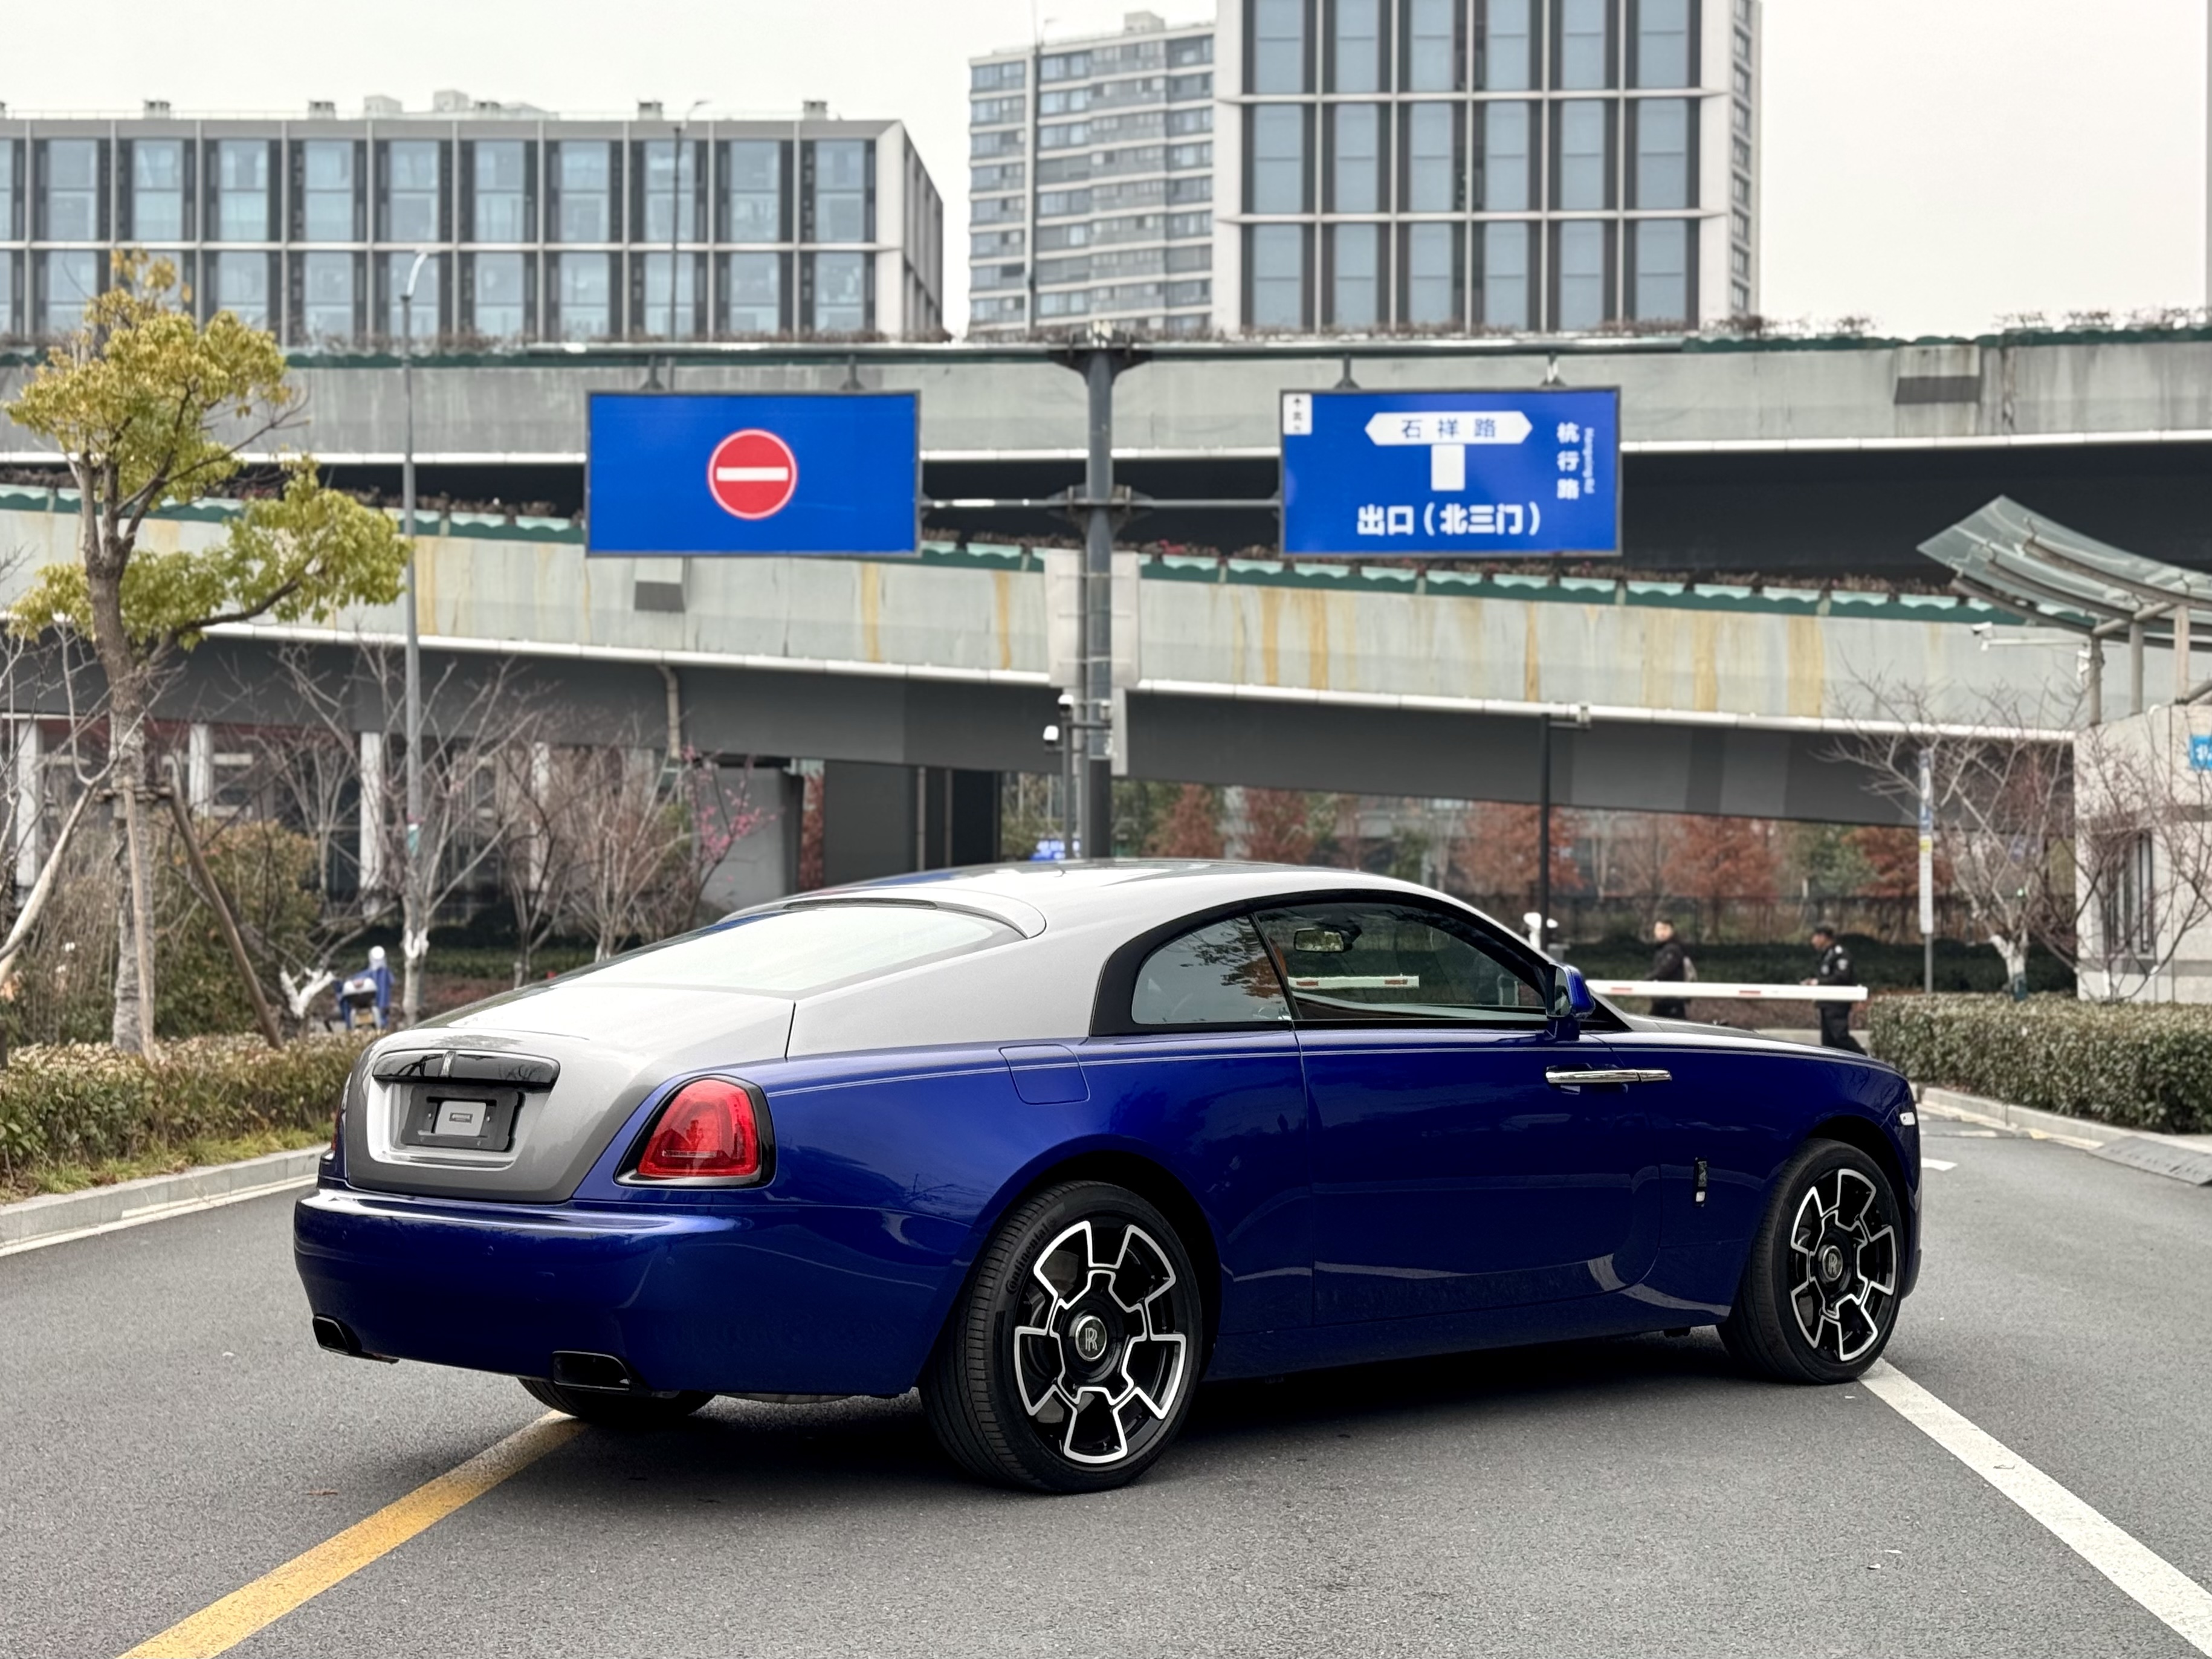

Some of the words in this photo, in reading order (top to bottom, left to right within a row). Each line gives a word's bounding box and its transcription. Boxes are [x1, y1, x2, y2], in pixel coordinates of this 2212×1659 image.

[1402, 418, 1495, 438] 石祥路
[1557, 422, 1580, 499] 杭行路
[1005, 1222, 1050, 1294] Continental
